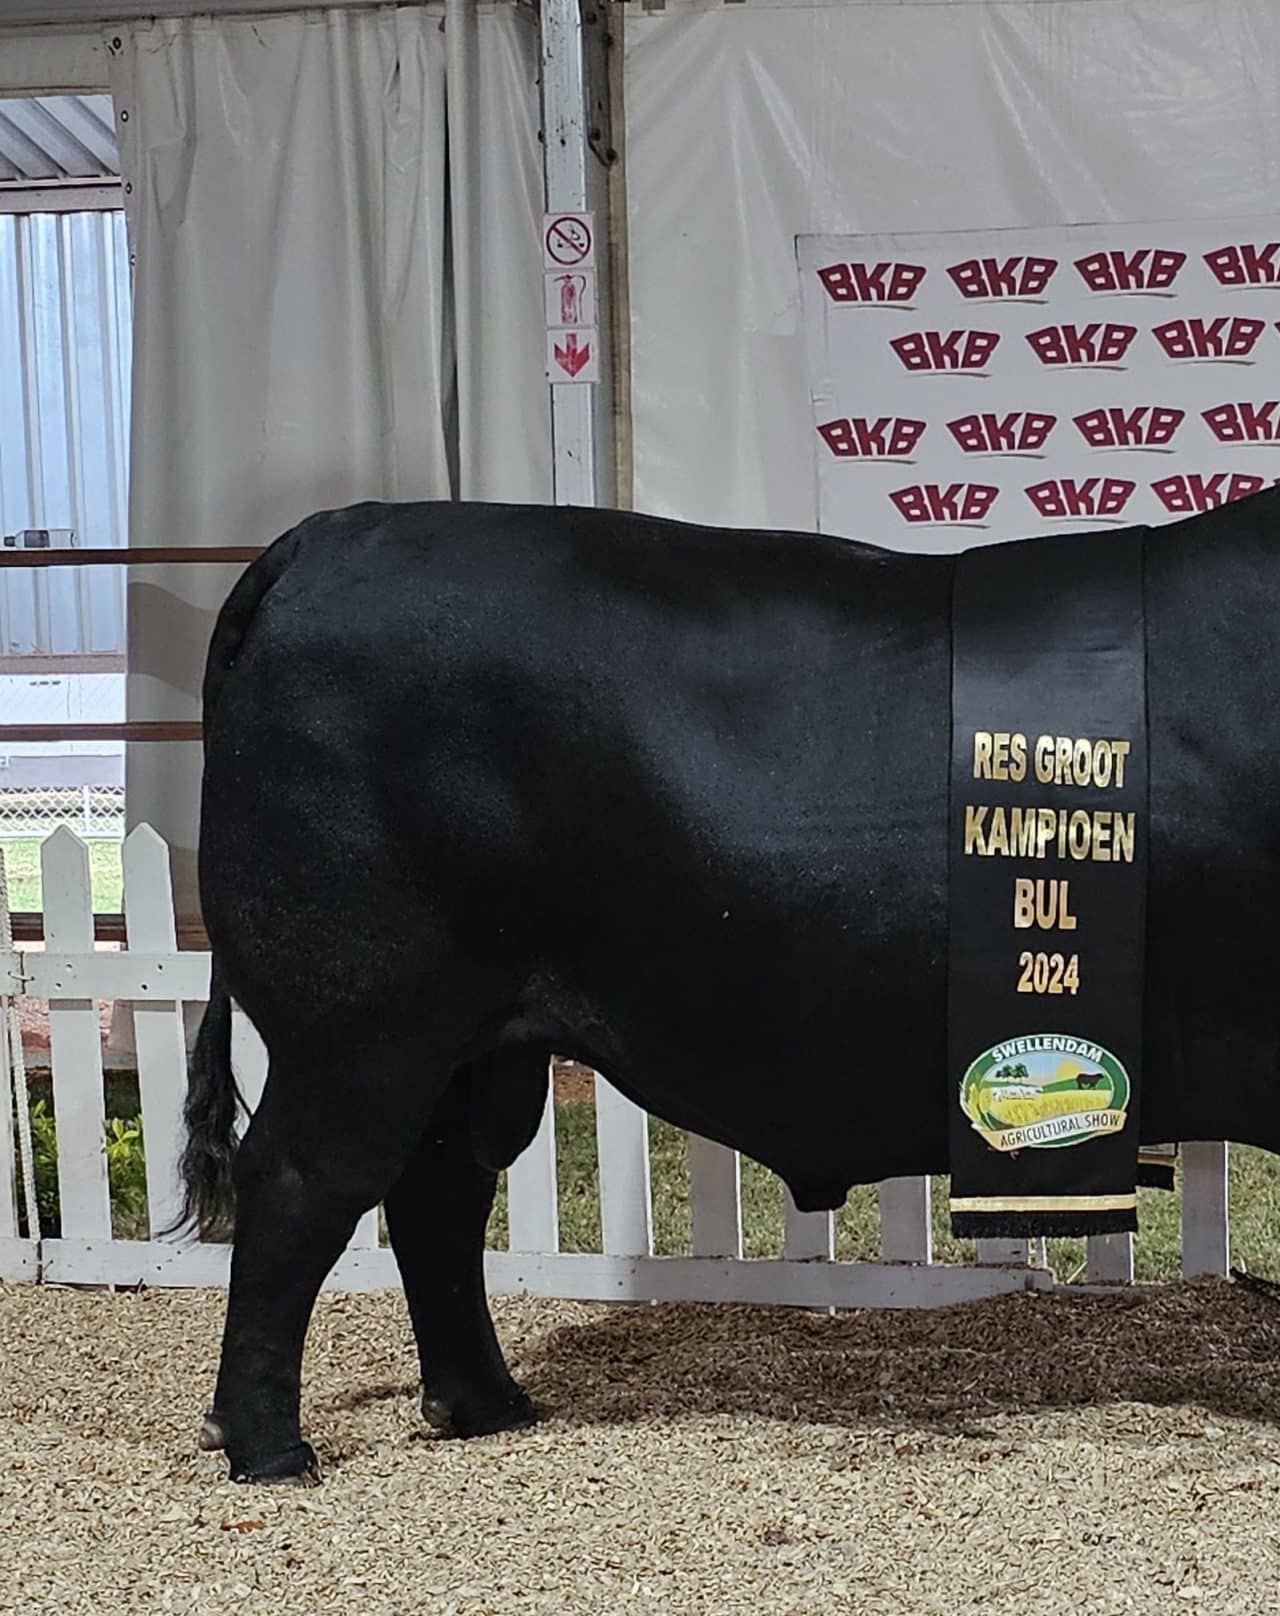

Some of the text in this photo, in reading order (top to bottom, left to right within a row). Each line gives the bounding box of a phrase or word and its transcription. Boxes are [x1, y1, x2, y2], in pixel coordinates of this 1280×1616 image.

[818, 263, 926, 301] BKB
[946, 258, 1058, 297] BKB
[1074, 249, 1187, 289] BKB
[889, 330, 1001, 369] BKB
[1025, 323, 1138, 364] BKB
[1152, 317, 1267, 358] BKB
[817, 418, 927, 456] BKB
[946, 414, 1058, 453] BKB
[1072, 407, 1185, 447] BKB
[889, 483, 1001, 522] BKB
[1024, 478, 1137, 517] BKB
[1150, 473, 1265, 512] BKB
[972, 731, 1131, 788] RES GROOT
[963, 805, 1136, 863] KAMPIOEN
[1013, 877, 1078, 930] BUL
[1016, 950, 1080, 995] 2024
[992, 1037, 1103, 1064] SWELLENDAM
[1000, 1112, 1121, 1148] AGRICULTURAL SHOW
